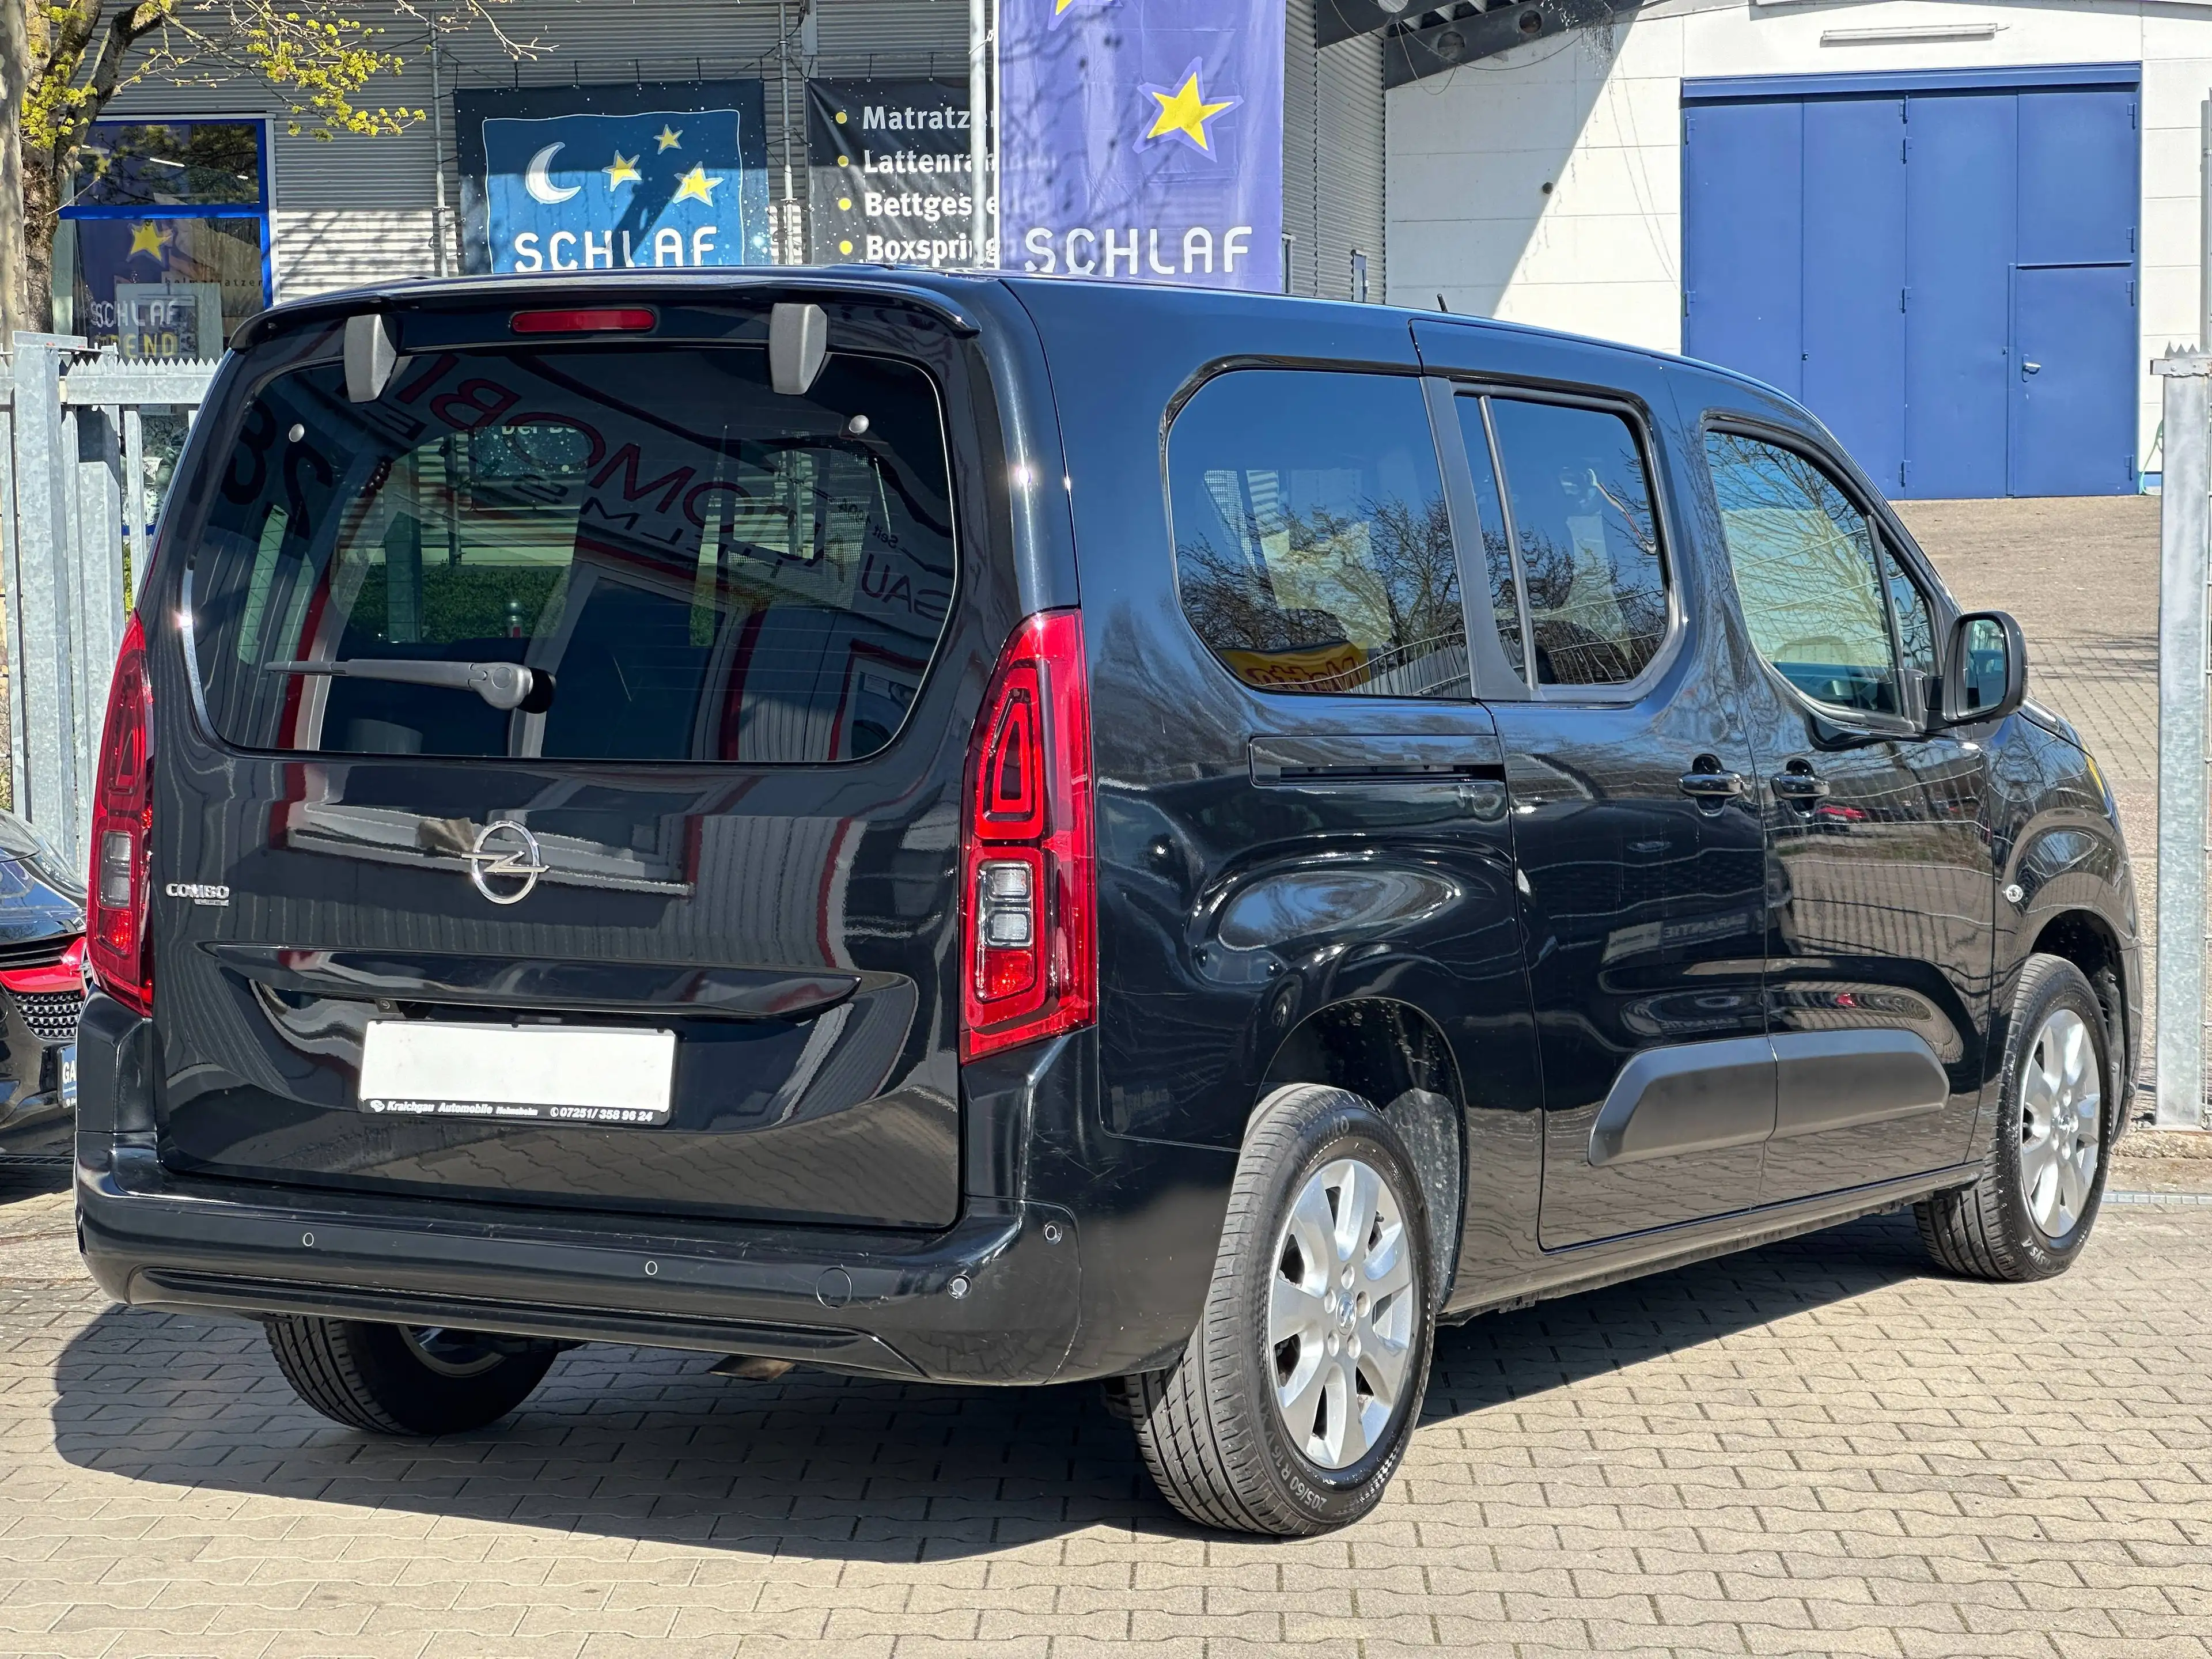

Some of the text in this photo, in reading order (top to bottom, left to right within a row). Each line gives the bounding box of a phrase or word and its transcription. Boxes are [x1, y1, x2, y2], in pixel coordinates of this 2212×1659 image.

[514, 226, 717, 272] SCHLAF
[1025, 226, 1252, 278] SCHLAF
[90, 298, 179, 328] SCHLAF
[166, 883, 230, 899] COMBO
[387, 1101, 435, 1114] Kraichgau
[438, 1103, 493, 1115] Automobile
[559, 1107, 600, 1119] 07251/
[599, 1109, 620, 1120] 358
[622, 1110, 637, 1121] 96
[637, 1111, 653, 1122] 24
[1271, 1445, 1284, 1468] 16
[1281, 1463, 1292, 1481] R
[1290, 1476, 1327, 1512] 205/60
